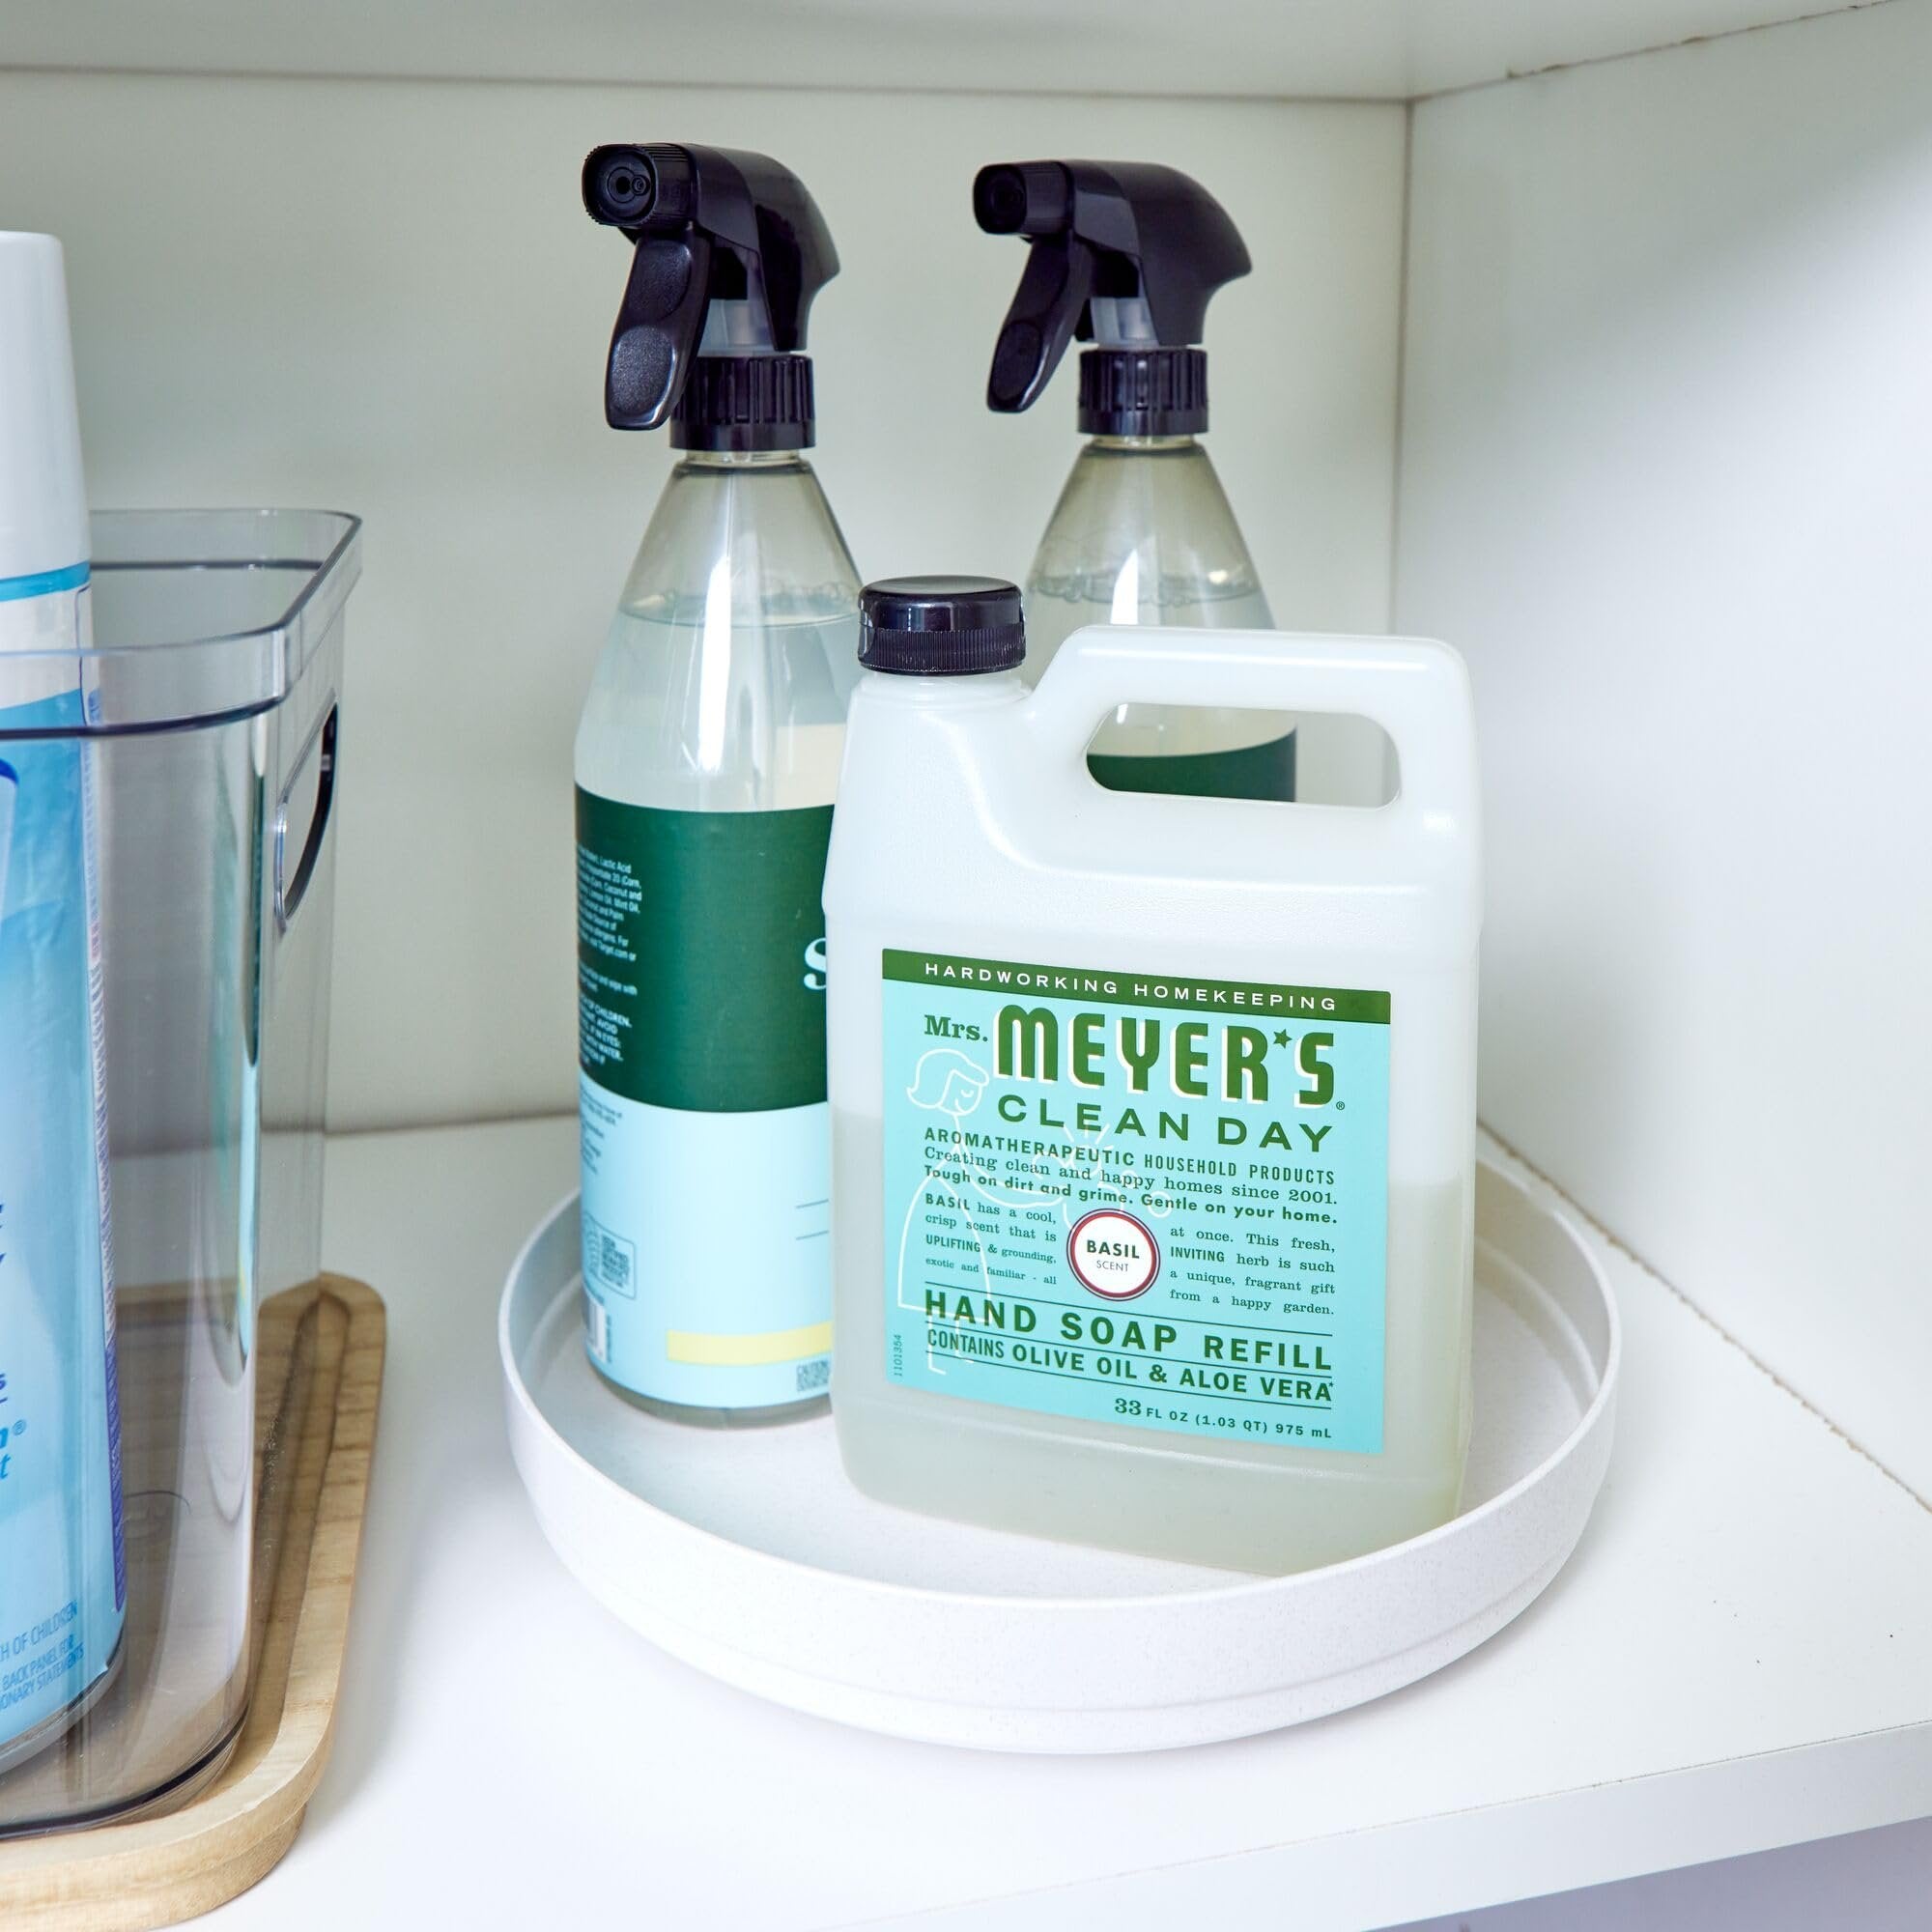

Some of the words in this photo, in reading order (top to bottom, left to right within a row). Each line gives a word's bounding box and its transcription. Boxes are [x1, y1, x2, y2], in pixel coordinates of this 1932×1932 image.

[924, 963, 1117, 994] HARDWORKING
[1134, 983, 1336, 1010] HOMEKEEPING
[923, 1014, 988, 1042] Mrs.
[998, 1094, 1188, 1141] CLEAN
[1217, 1117, 1333, 1152] DAY
[924, 1127, 1135, 1166] AROMATHERAPEUTIC
[1144, 1153, 1237, 1177] HOUSEHOLD
[1249, 1164, 1335, 1185] PRODUCTS
[924, 1146, 998, 1171] Creating
[1006, 1158, 1051, 1176] clean
[1059, 1167, 1092, 1180] and
[1099, 1169, 1155, 1191] happy
[1164, 1177, 1223, 1195] homes
[1231, 1184, 1280, 1200] since
[1288, 1189, 1338, 1205] 2001.
[924, 1165, 971, 1184] Tough
[978, 1176, 998, 1186] on
[1005, 1176, 1034, 1191] dirt
[1040, 1183, 1072, 1197] and
[1078, 1186, 1134, 1204] grime.
[1141, 1193, 1198, 1210] Gentle
[1205, 1203, 1226, 1214] on
[1234, 1207, 1275, 1219] your
[1282, 1207, 1338, 1224] home.
[924, 1192, 971, 1210] BASIL
[977, 1202, 1001, 1215] has
[1009, 1208, 1017, 1218] a
[1026, 1210, 1057, 1225] cool,
[924, 1213, 957, 1230] crisp
[966, 1221, 1000, 1235] scent
[1009, 1226, 1037, 1239] that
[1044, 1230, 1057, 1242] is
[1170, 1226, 1185, 1237] at
[1196, 1230, 1234, 1242] once.
[1245, 1233, 1280, 1247] This
[1291, 1236, 1336, 1253] fresh,
[925, 1234, 981, 1253] UPLIFTING
[987, 1243, 998, 1254] &
[1086, 1238, 1140, 1260] BASIL
[1170, 1245, 1225, 1263] INVITING
[1236, 1253, 1269, 1267] herb
[1278, 1257, 1292, 1269] is
[1299, 1261, 1335, 1273] such
[924, 1257, 954, 1268] exotic
[960, 1263, 980, 1273] and
[986, 1266, 1026, 1281] familiar
[1043, 1275, 1057, 1285] all
[1095, 1260, 1129, 1272] SCENT
[1170, 1270, 1178, 1279] a
[1186, 1270, 1236, 1286] unique,
[1244, 1276, 1302, 1292] fragrant
[1310, 1283, 1335, 1295] gift
[1169, 1290, 1202, 1302] from
[1212, 1295, 1220, 1304] a
[1231, 1295, 1271, 1311] happy
[1283, 1301, 1335, 1316] garden.
[924, 1289, 1037, 1333] HAND
[1060, 1312, 1178, 1352] SOAP
[1204, 1334, 1332, 1371] REFILL
[926, 1328, 1005, 1358] CONTAINS
[1012, 1344, 1085, 1372] OLIVE
[1096, 1357, 1138, 1379] OIL
[1149, 1364, 1167, 1383] &
[1179, 1368, 1247, 1393] ALOE
[1114, 1398, 1142, 1416] 33
[1146, 1407, 1162, 1419] FL
[1169, 1410, 1188, 1422] OZ
[1195, 1413, 1236, 1429] (1.03
[1242, 1420, 1267, 1435] QT)
[1275, 1423, 1303, 1435] 975
[1311, 1428, 1332, 1438] mL
[30, 1599, 77, 1646] CHILDREN
